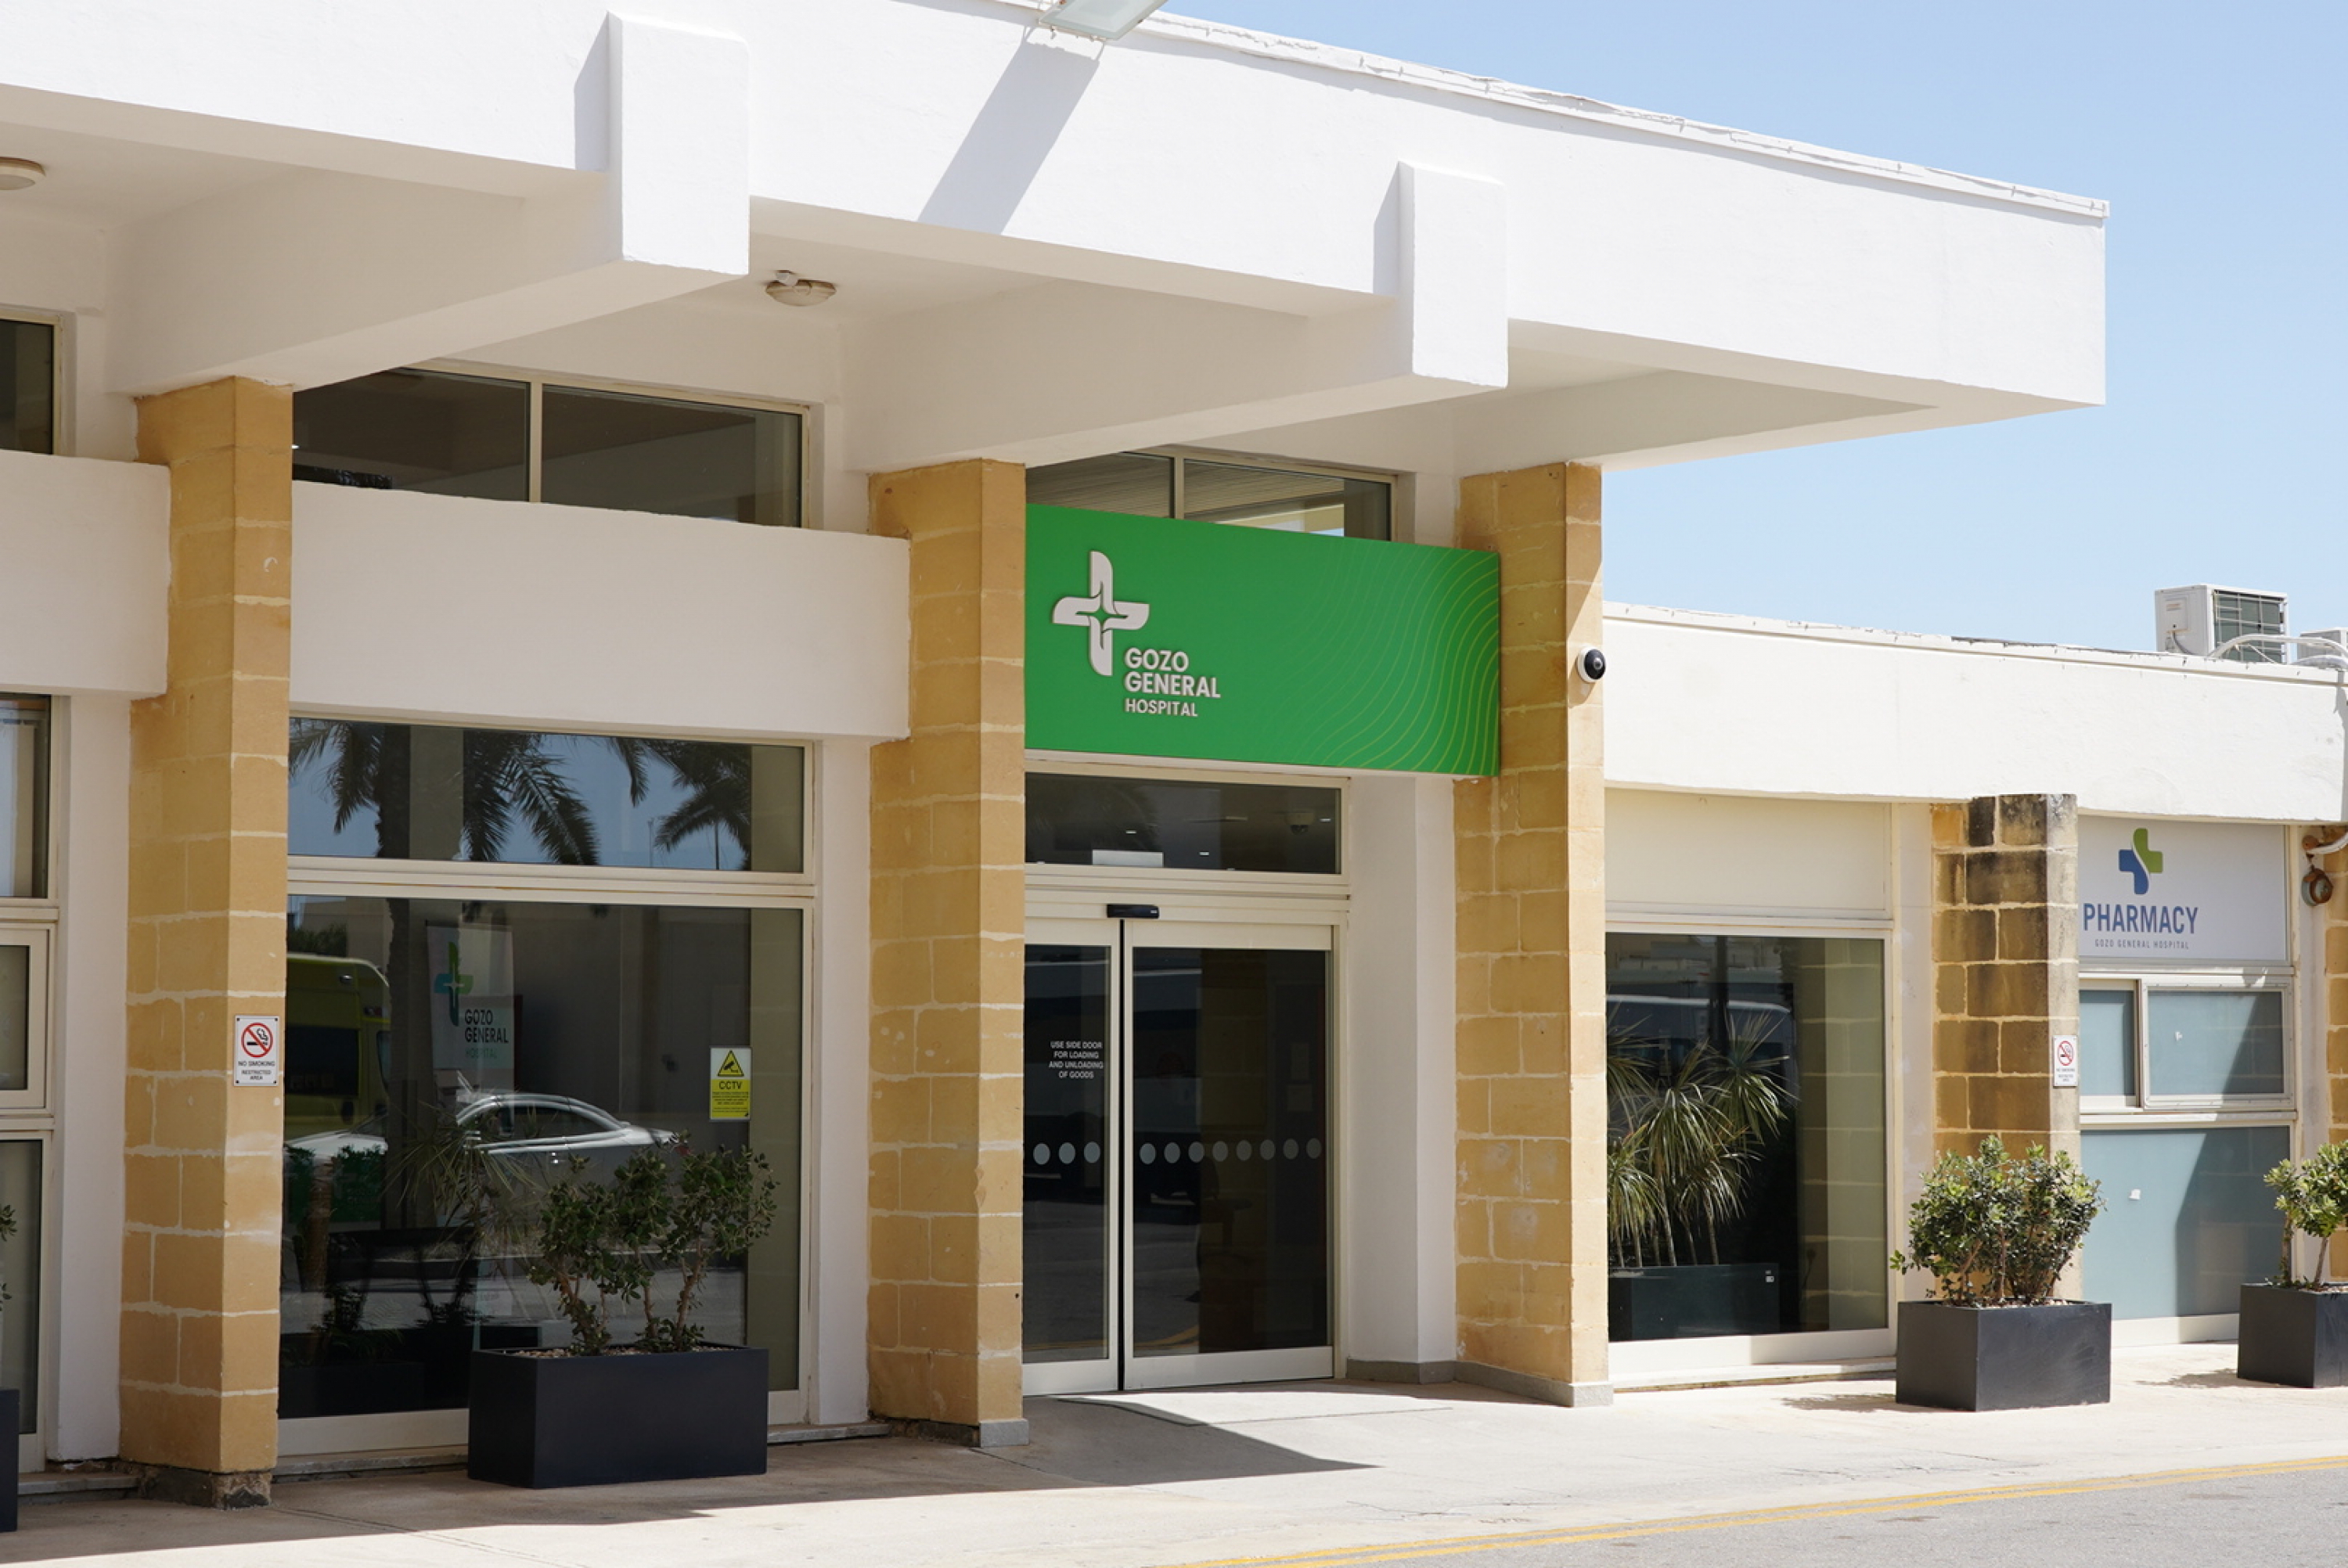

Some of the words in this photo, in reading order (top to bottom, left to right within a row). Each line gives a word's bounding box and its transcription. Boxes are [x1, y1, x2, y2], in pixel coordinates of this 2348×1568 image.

[1125, 647, 1189, 672] GOZO
[1125, 671, 1221, 698] GENERAL
[1125, 698, 1197, 717] HOSPITAL
[2083, 902, 2199, 934] PHARMACY
[2094, 939, 2114, 948] GOZO
[2117, 939, 2150, 948] GENERAL
[2154, 940, 2189, 950] HOSPITAL
[465, 1009, 493, 1025] GOZO
[465, 1027, 509, 1043] GENERAL
[1069, 1070, 1094, 1079] GOODS
[718, 1081, 742, 1090] CCTV
